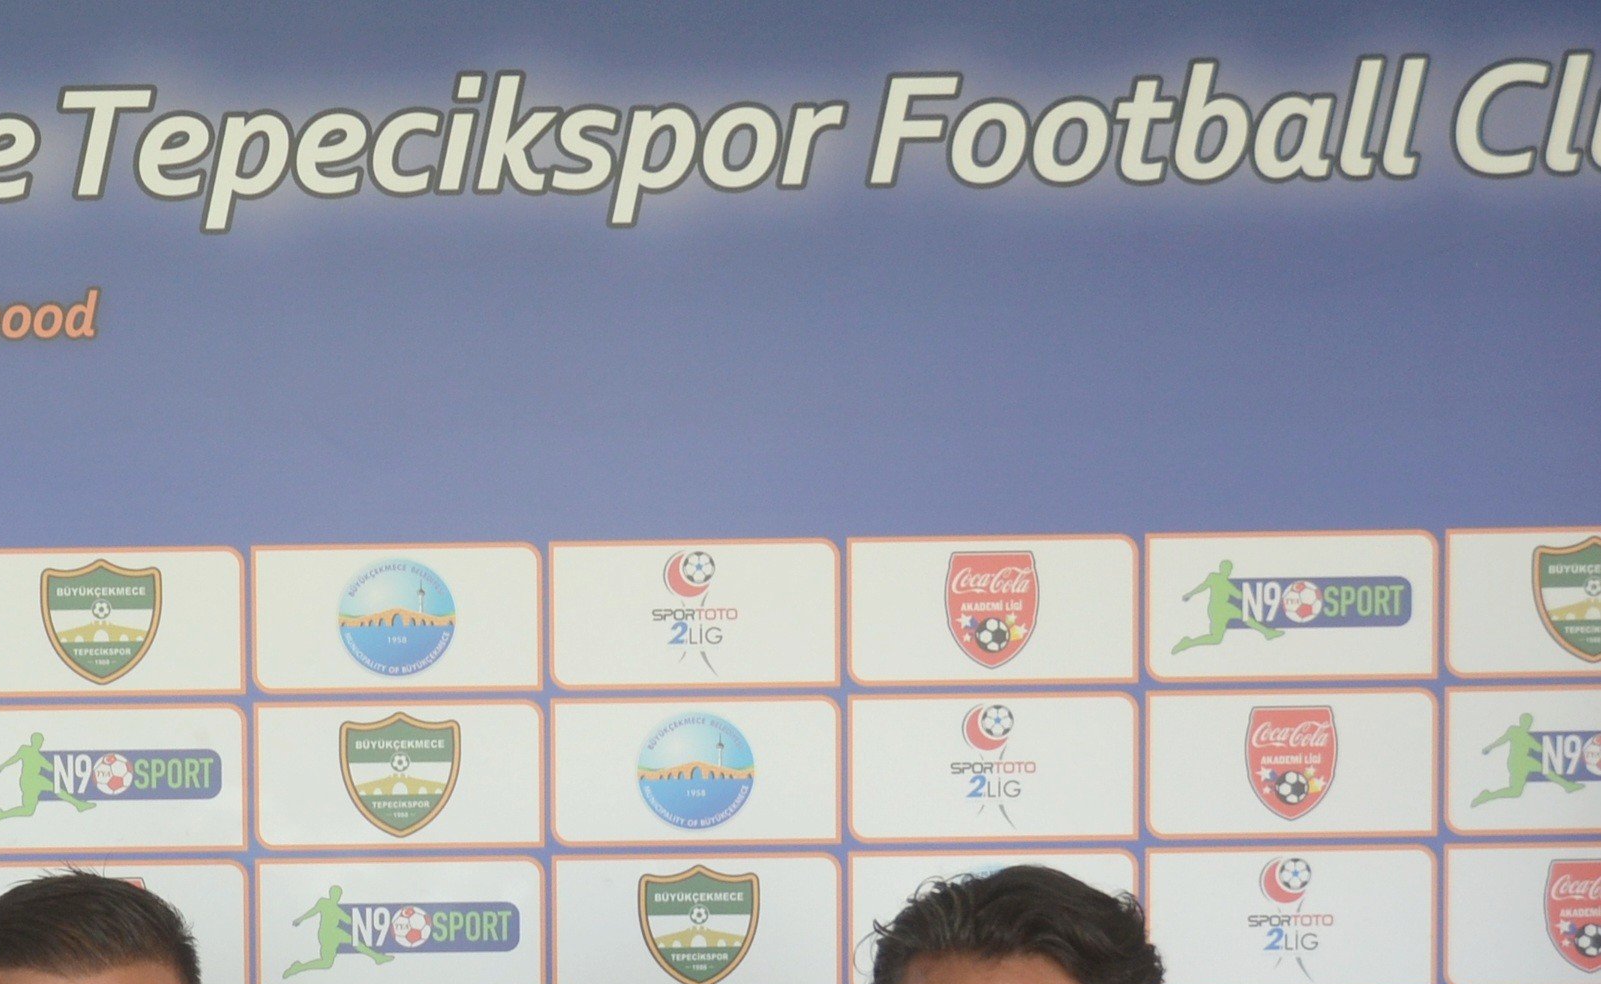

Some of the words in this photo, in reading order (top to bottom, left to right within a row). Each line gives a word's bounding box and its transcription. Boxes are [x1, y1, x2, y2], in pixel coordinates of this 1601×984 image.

[58, 73, 847, 231] Tepecikspor
[868, 56, 1427, 189] Football
[1323, 585, 1404, 617] SPORT
[134, 758, 213, 789] SPORT
[432, 911, 512, 942] SPORT
